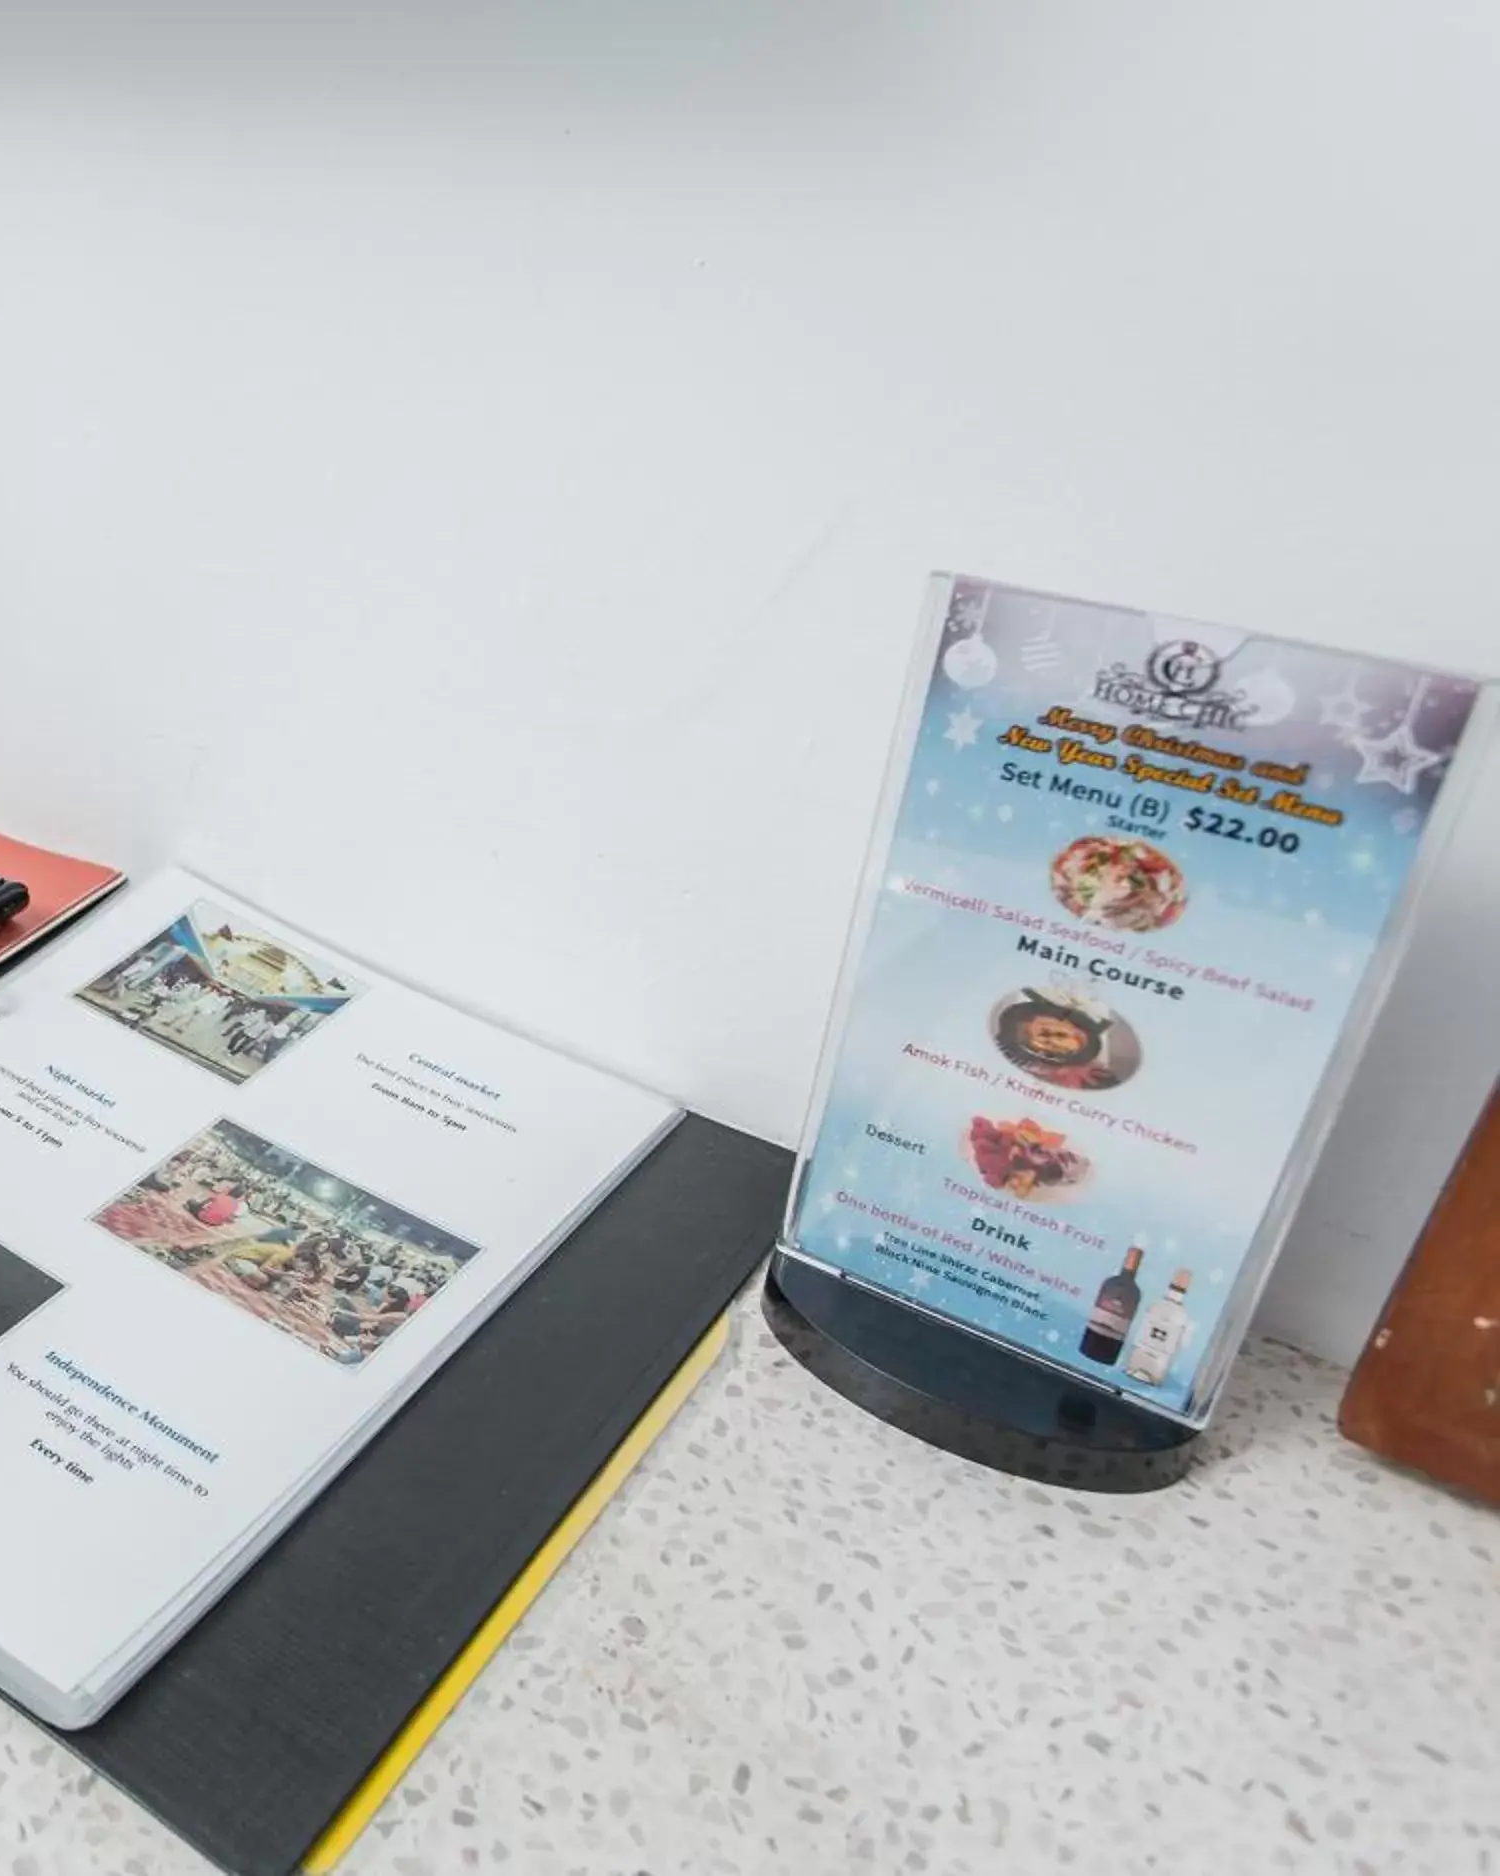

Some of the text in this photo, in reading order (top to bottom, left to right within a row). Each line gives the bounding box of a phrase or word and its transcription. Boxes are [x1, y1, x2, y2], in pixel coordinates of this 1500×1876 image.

[996, 725, 1344, 826] New Year Special Set Menu
[1036, 705, 1117, 744] Merry
[1120, 724, 1246, 770] Christmas
[1250, 761, 1311, 786] and
[999, 761, 1300, 854] Set Menu (B) $22.00
[1107, 813, 1168, 840] Starter
[902, 878, 987, 915] Vermicelli
[992, 903, 1046, 932] Salad
[1050, 920, 1126, 956] Seafood
[1144, 948, 1200, 979] Spicy
[1202, 968, 1251, 994] Beef
[1254, 983, 1316, 1013] Salad
[1016, 934, 1185, 1001] Main Course
[409, 1053, 500, 1100] Central market
[902, 1043, 953, 1069] Amok
[954, 1060, 990, 1083] Fish
[1005, 1076, 1064, 1107] Khmer
[1068, 1099, 1118, 1129] Curry
[1121, 1118, 1198, 1155] Chicken
[865, 1122, 927, 1155] Dessert
[836, 1190, 867, 1212] One
[870, 1202, 919, 1232] bottle
[921, 1223, 940, 1240] of
[940, 1229, 974, 1253] Red
[988, 1249, 1036, 1277] White
[1038, 1272, 1082, 1298] wine
[943, 1177, 1106, 1251] Tropical Fresh Fruit
[971, 1217, 1033, 1251] Drink
[939, 1252, 978, 1277] Shiraz
[943, 1269, 1010, 1305] Sauvignon
[1011, 1298, 1049, 1322] Blanc
[45, 1351, 138, 1414] Independence
[7, 1361, 209, 1498] You should go there at night time to
[29, 1438, 94, 1485] Every time
[45, 1410, 134, 1471] enjoy the lights
